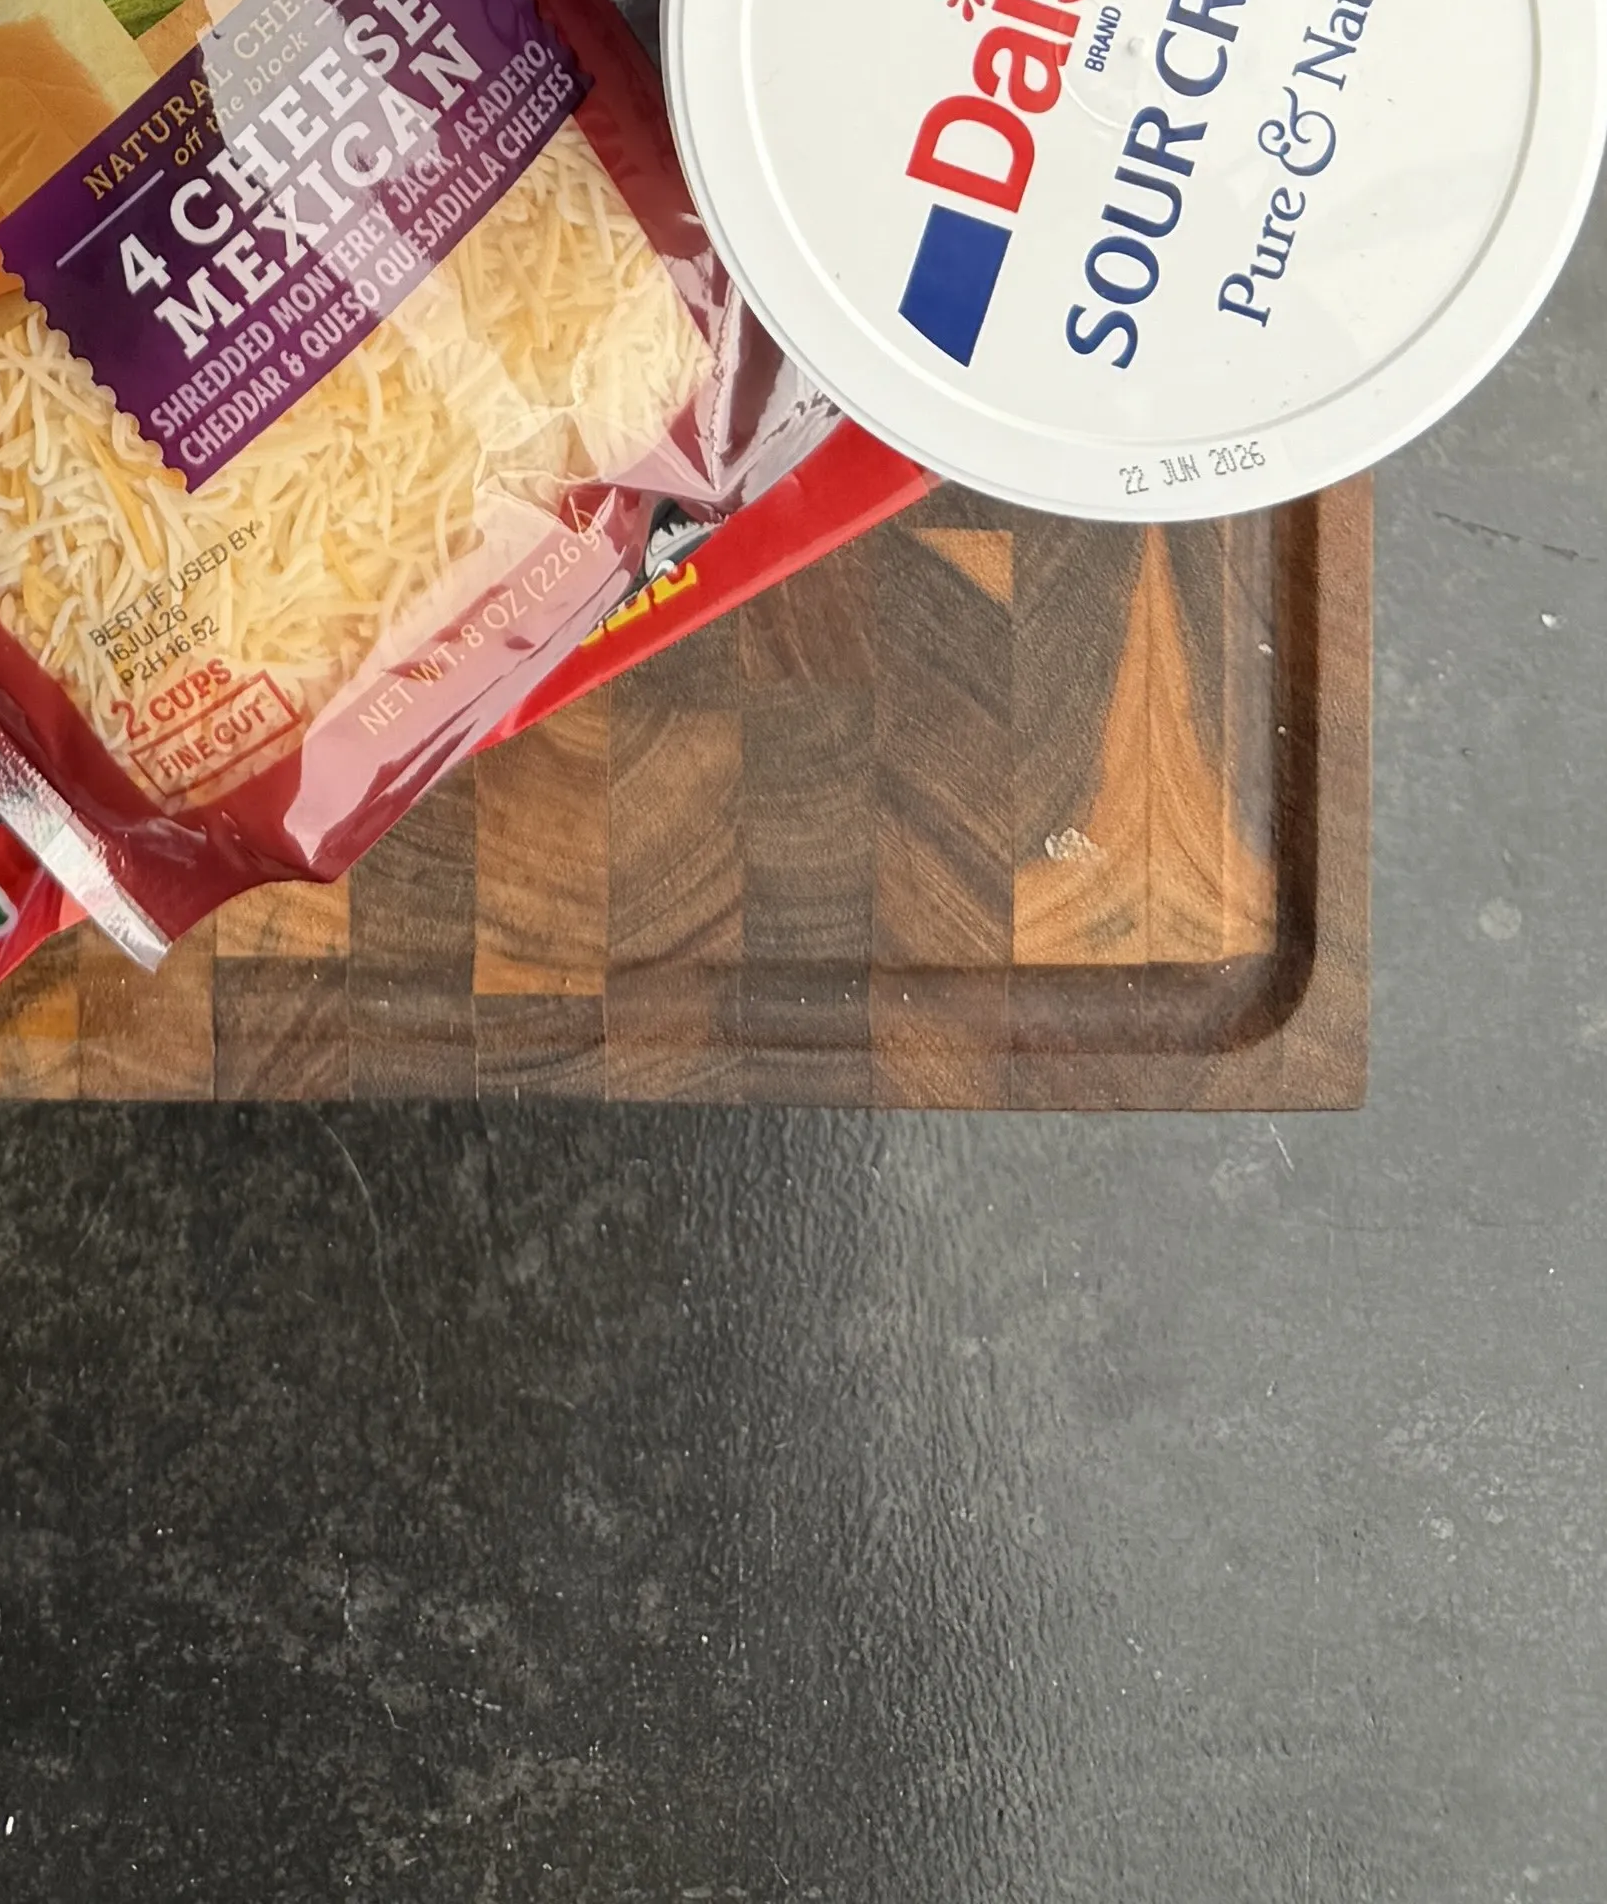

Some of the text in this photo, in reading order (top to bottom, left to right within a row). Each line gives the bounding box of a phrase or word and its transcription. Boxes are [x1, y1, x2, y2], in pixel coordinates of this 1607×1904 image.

[166, 26, 312, 168] off the block
[1084, 5, 1122, 73] BRAND
[81, 54, 236, 200] NATURAL
[152, 23, 484, 359] MEXICAN
[1258, 90, 1336, 178] &
[122, 227, 176, 303] 4
[148, 37, 555, 439] SHREDDED MONTEREY JACK, ASADERO,
[175, 61, 576, 469] CHEDDAR & QUESO QUESADILLA CHEESES
[1065, 104, 1208, 369] SOUR
[1218, 192, 1305, 327] Pure
[1118, 441, 1265, 494] 22 JUN 2026
[88, 520, 258, 648] BEST IF USED BY
[104, 603, 188, 666] 16JUL26
[108, 654, 234, 741] 2 CUPS
[357, 676, 415, 735] NET
[410, 640, 466, 690] WT.
[458, 621, 485, 650] 8
[479, 588, 529, 633] OZ
[156, 697, 268, 781] FINE CUT
